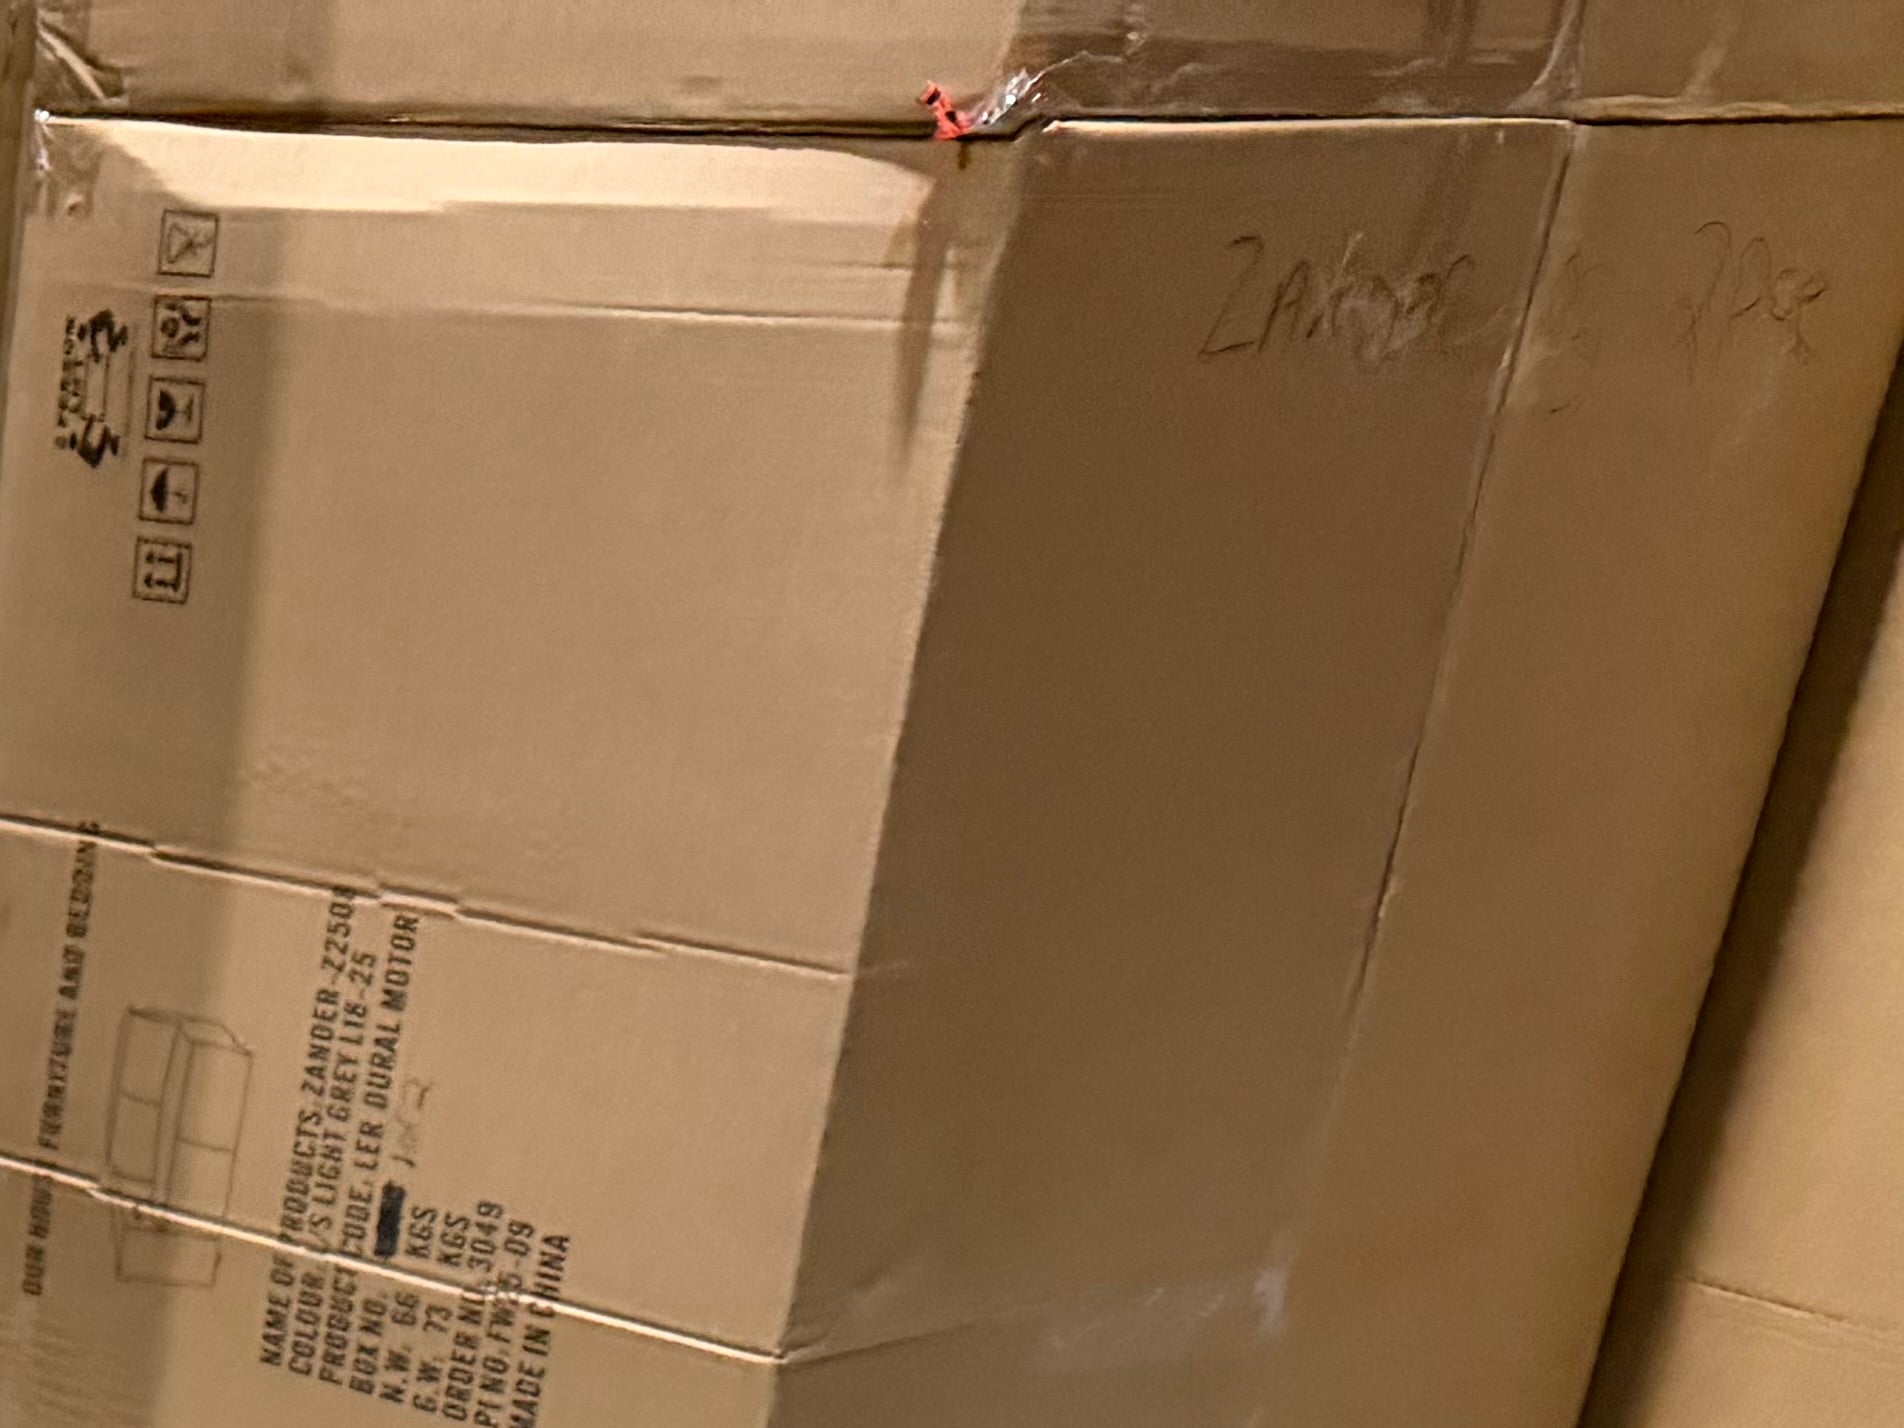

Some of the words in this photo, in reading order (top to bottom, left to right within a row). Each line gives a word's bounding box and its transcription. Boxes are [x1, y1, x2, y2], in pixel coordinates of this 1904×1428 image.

[379, 911, 419, 1012] MOTOR
[40, 1005, 75, 1151] FURNITURE
[326, 1052, 358, 1122] GREY
[363, 1018, 400, 1110] DURAL
[313, 1128, 345, 1205] LIGHT
[354, 1119, 383, 1171] LER
[30, 1165, 55, 1238] HOUS
[406, 1203, 436, 1258] KGS
[22, 1243, 45, 1295] OUR
[273, 1253, 294, 1287] OF
[423, 1302, 451, 1336] 73
[437, 1210, 467, 1267] KGS
[528, 1229, 568, 1320] CHINA
[259, 1289, 290, 1367] NAME
[442, 1332, 480, 1421] ORDER
[467, 1199, 502, 1274] 3049
[522, 1324, 549, 1356] IN
[349, 1343, 379, 1395] BOX
